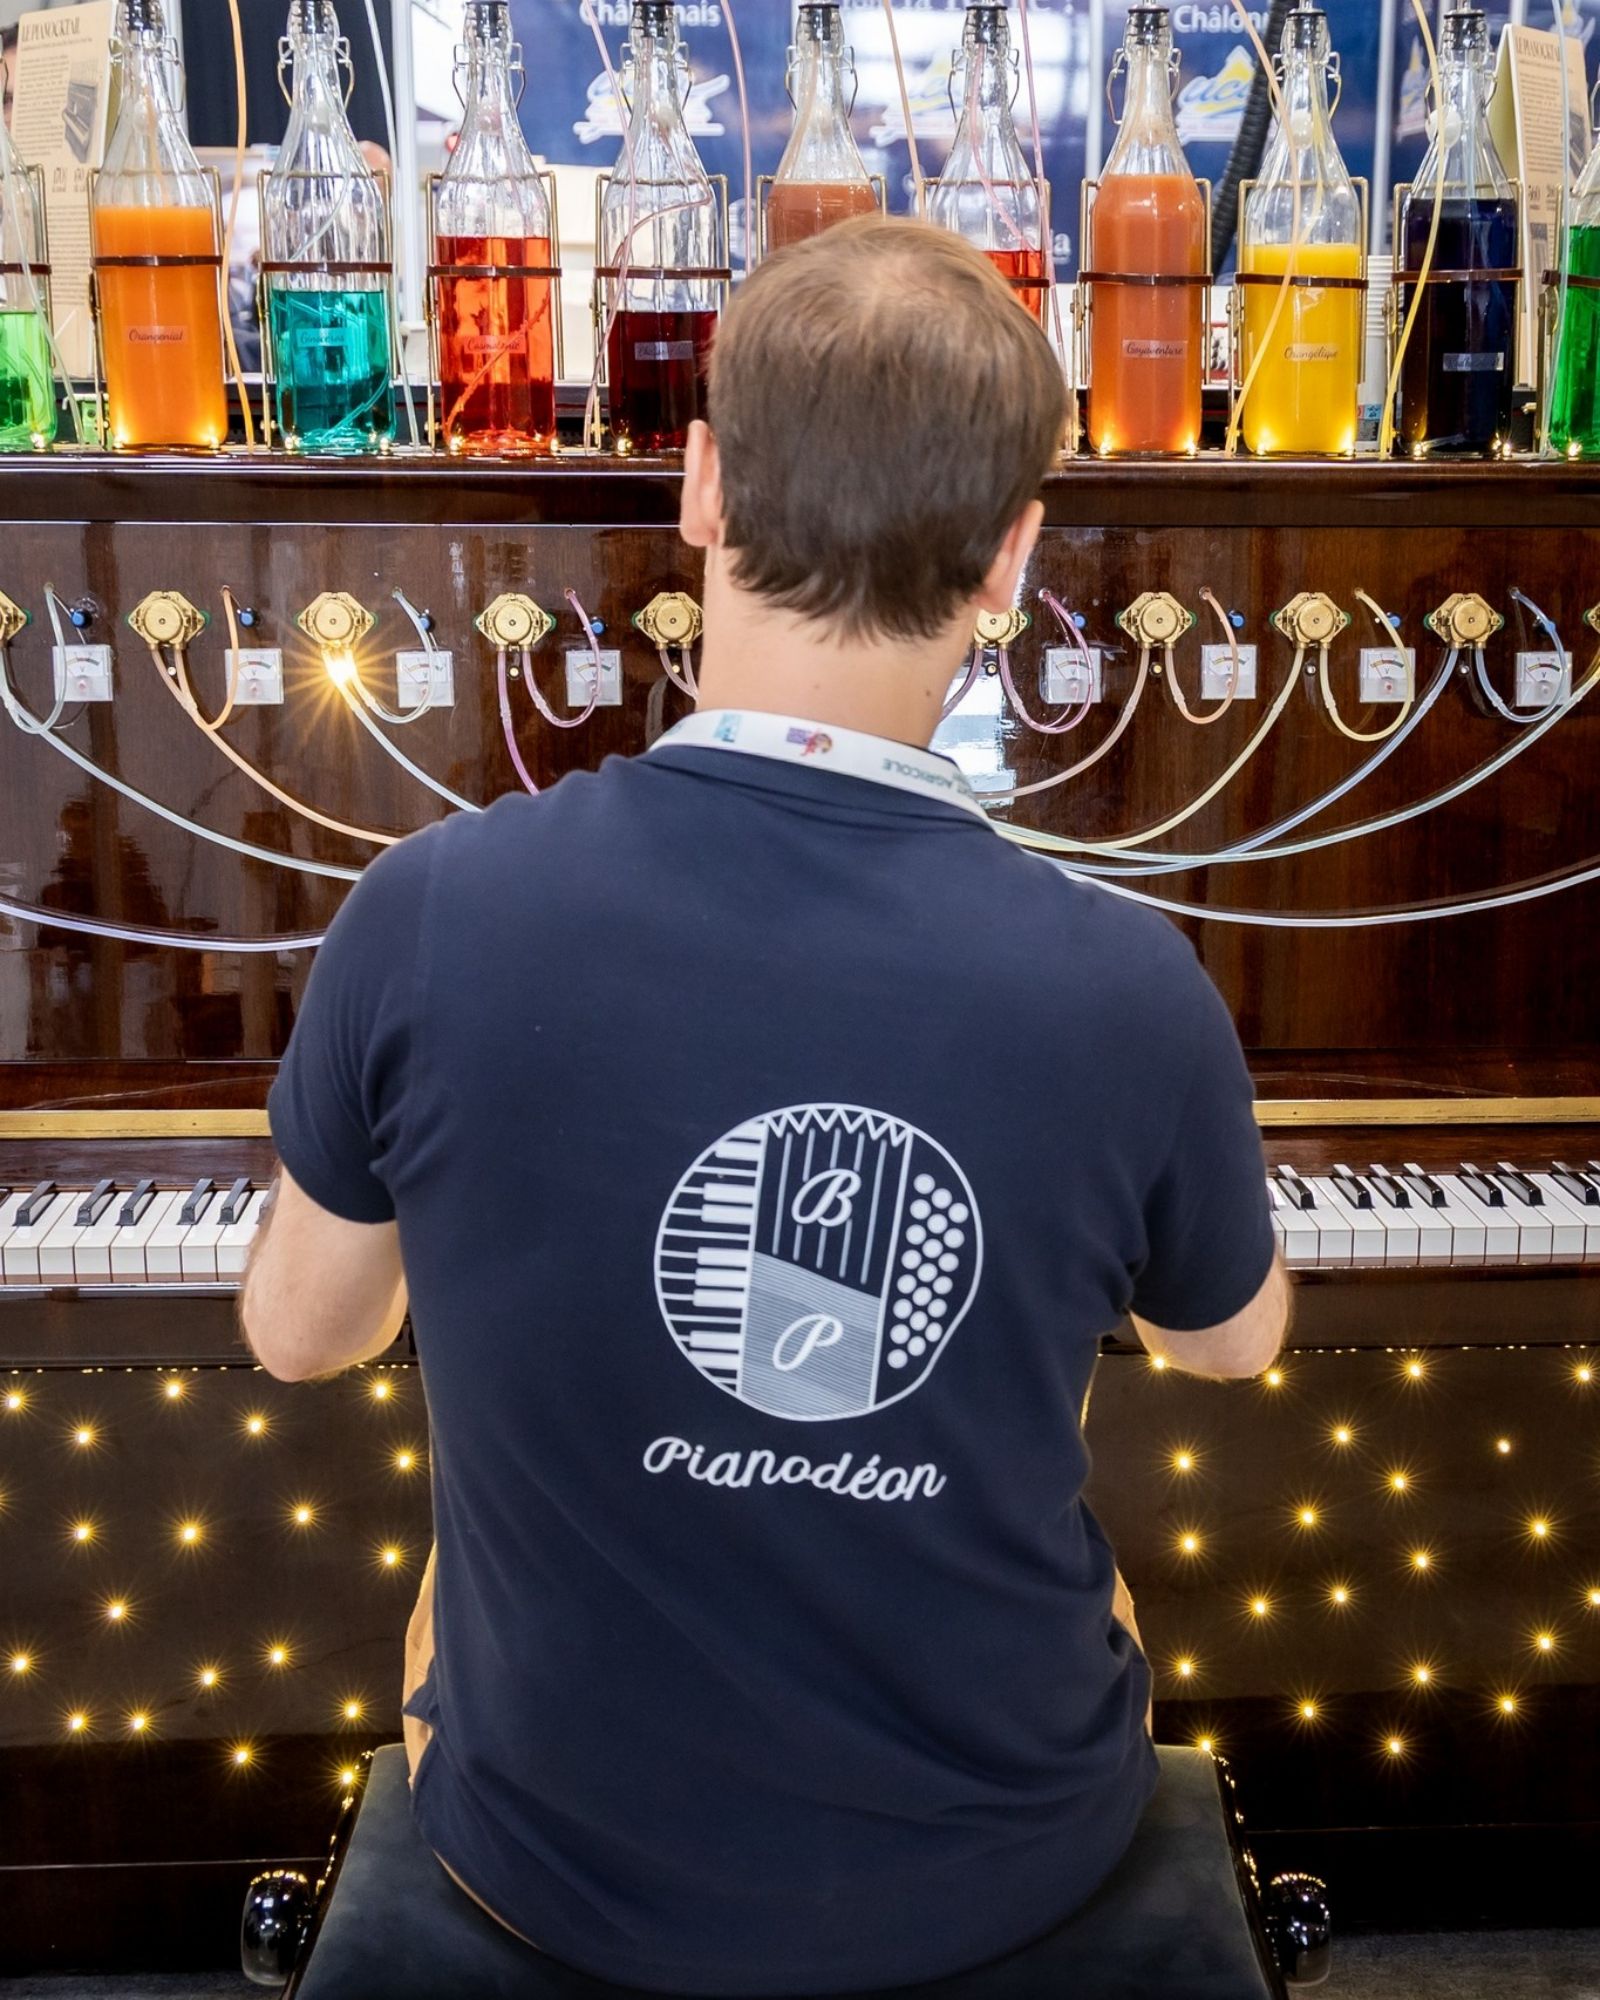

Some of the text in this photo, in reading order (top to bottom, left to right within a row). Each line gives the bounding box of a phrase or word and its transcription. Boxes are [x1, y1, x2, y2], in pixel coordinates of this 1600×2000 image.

[791, 1168, 862, 1228] B
[772, 1313, 844, 1372] P
[643, 1435, 947, 1501] Pianodéon
